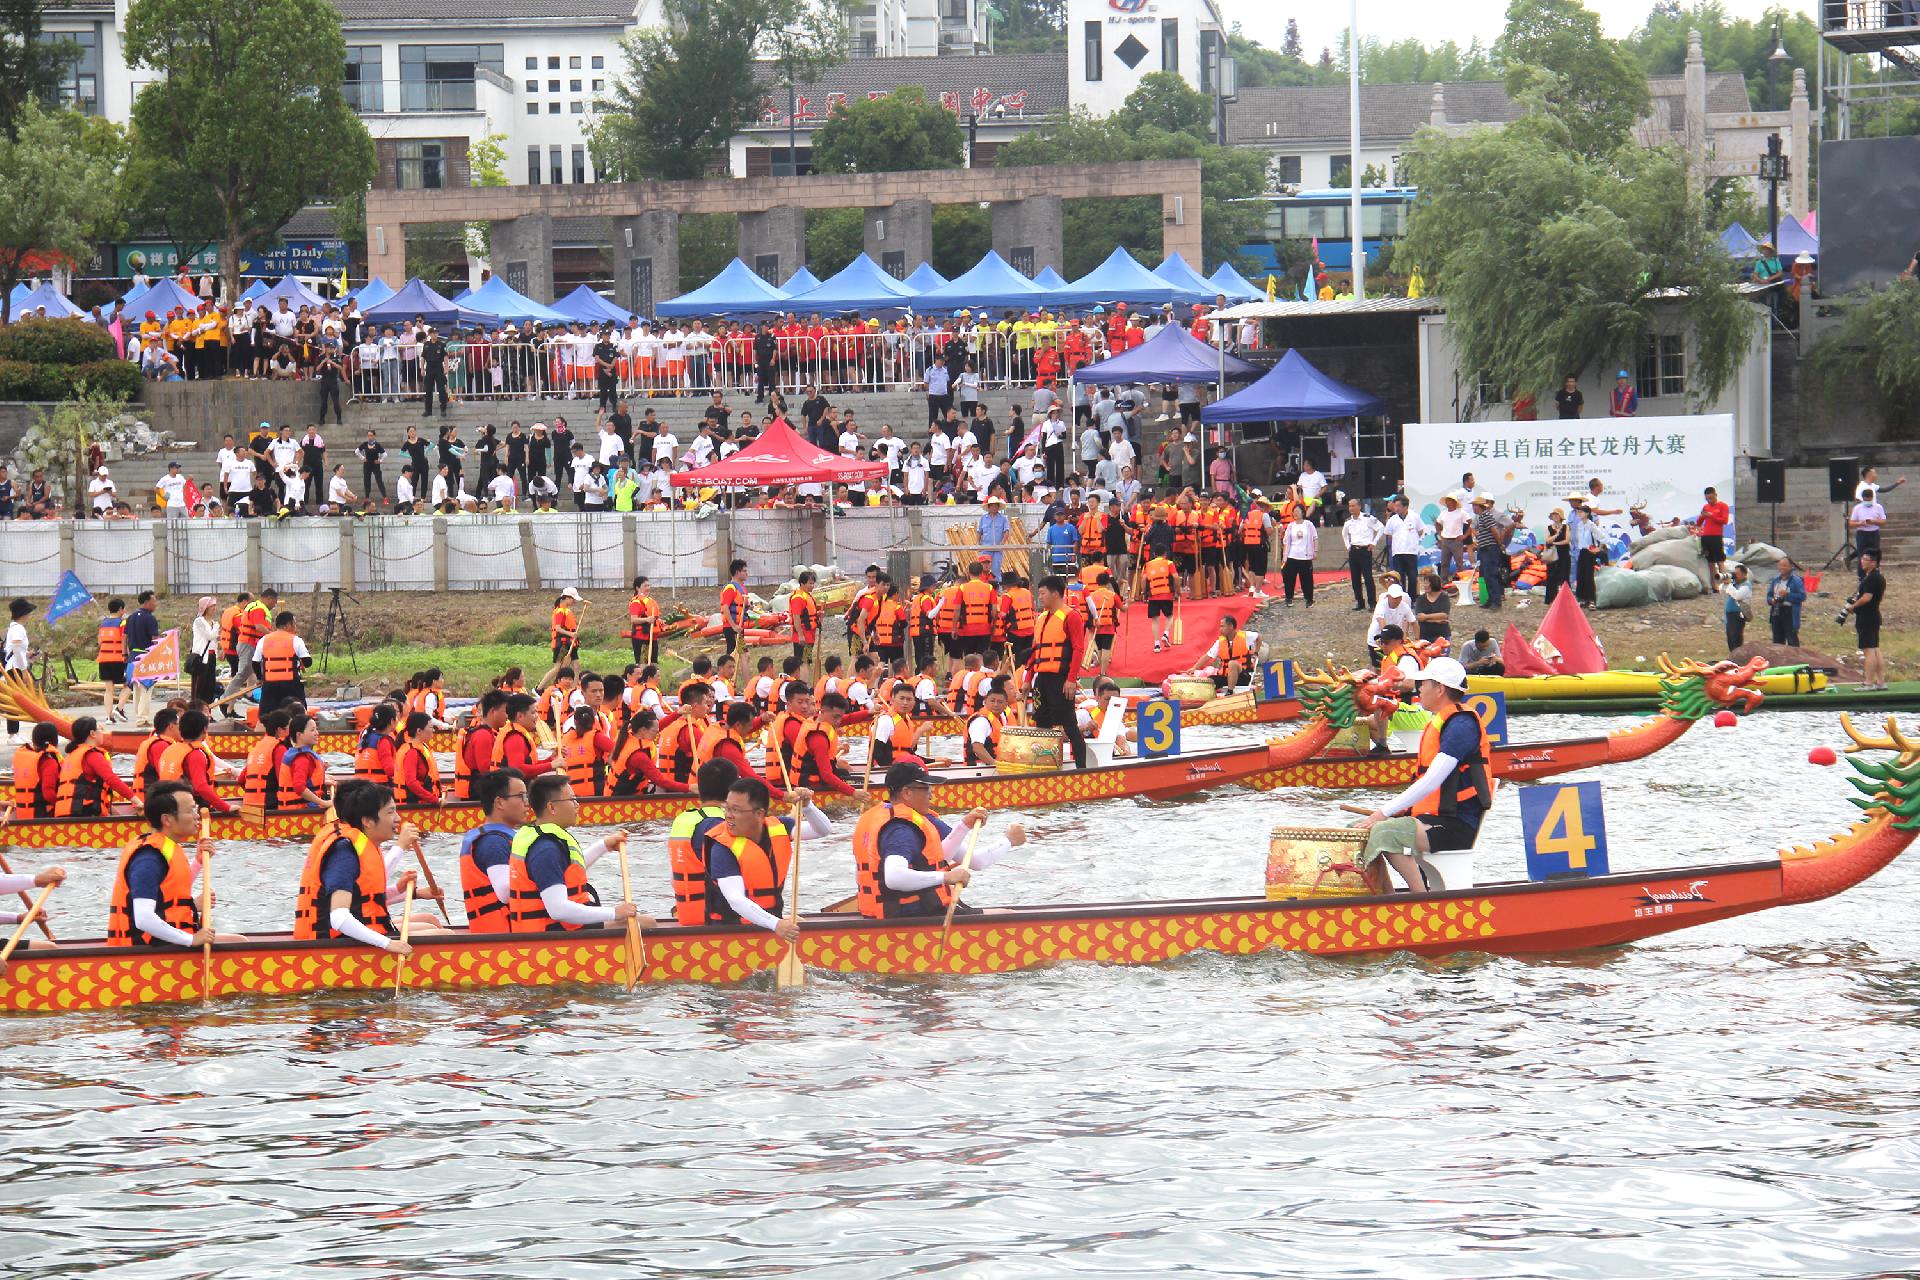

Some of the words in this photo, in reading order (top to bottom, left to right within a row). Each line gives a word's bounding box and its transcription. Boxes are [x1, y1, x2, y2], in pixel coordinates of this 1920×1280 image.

[259, 249, 287, 258] are
[292, 247, 323, 259] Daily
[1448, 434, 1686, 459] 淳安县首届全民龙舟大赛
[1270, 661, 1286, 696] 1
[1144, 701, 1173, 751] 3
[1465, 695, 1500, 742] 2
[1535, 786, 1596, 869] 4
